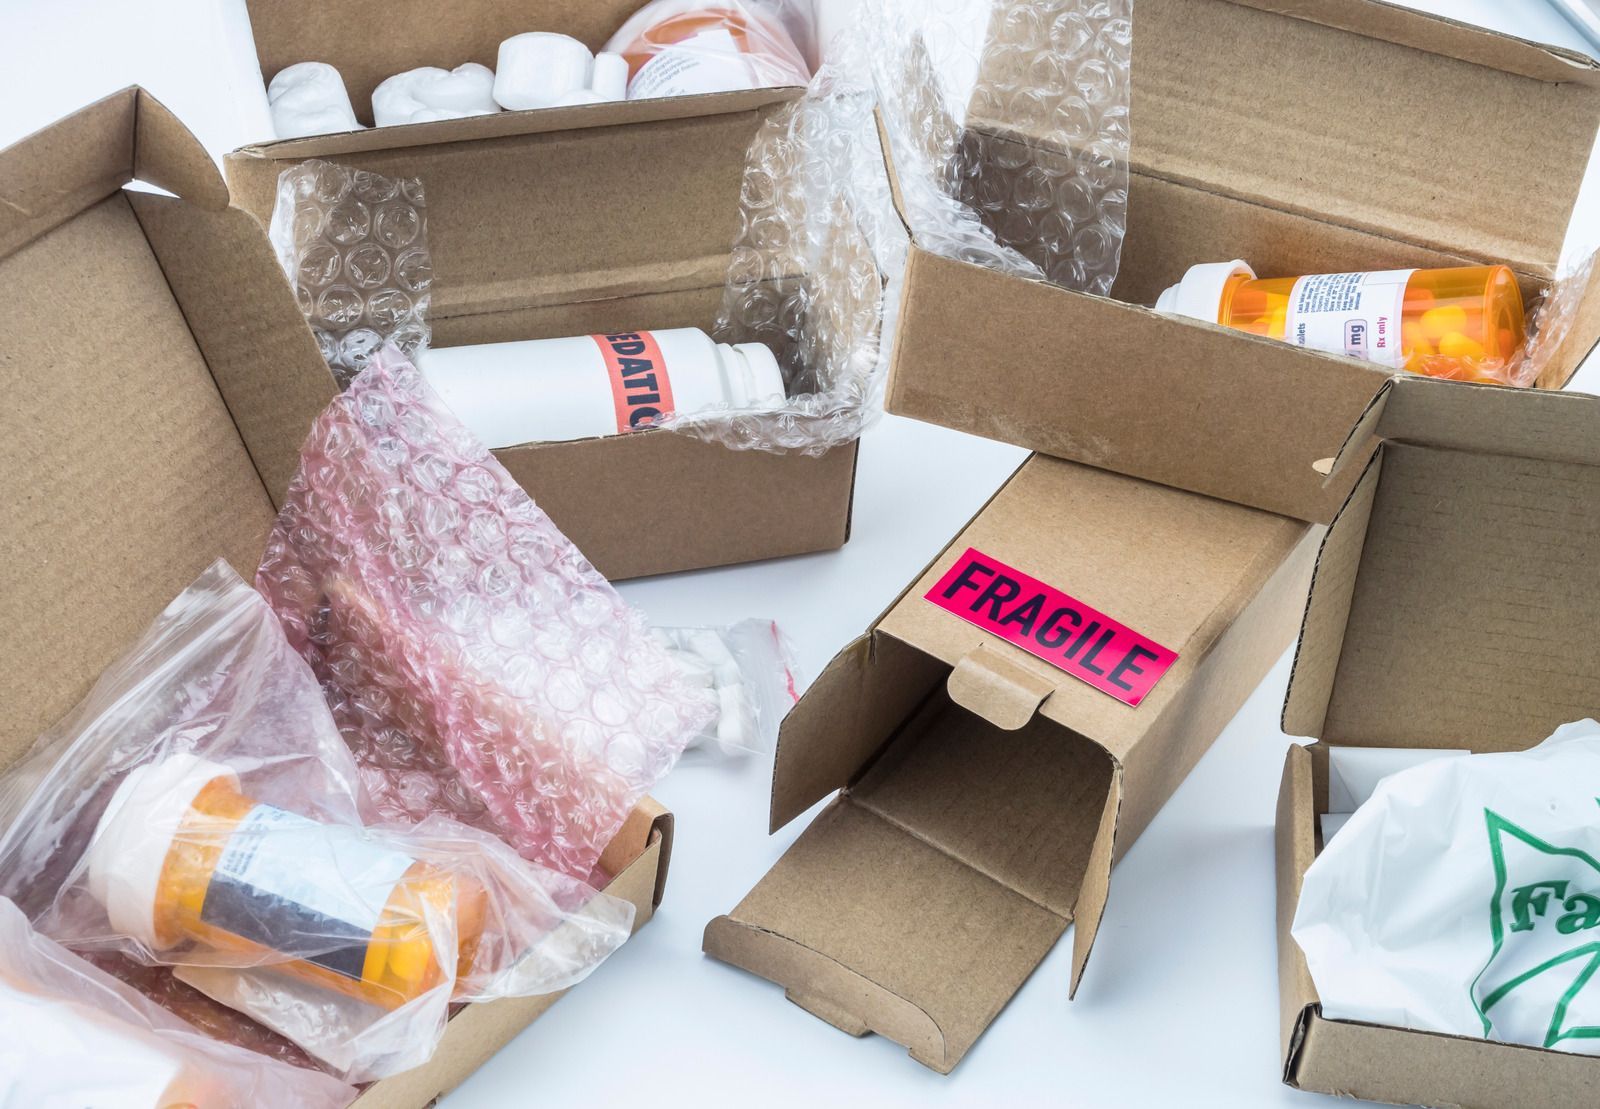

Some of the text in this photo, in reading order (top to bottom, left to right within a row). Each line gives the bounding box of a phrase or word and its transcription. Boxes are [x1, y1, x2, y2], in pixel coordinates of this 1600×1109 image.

[1351, 325, 1364, 346] mg
[1377, 316, 1388, 348] Rx only
[942, 561, 1159, 692] FRAGILE
